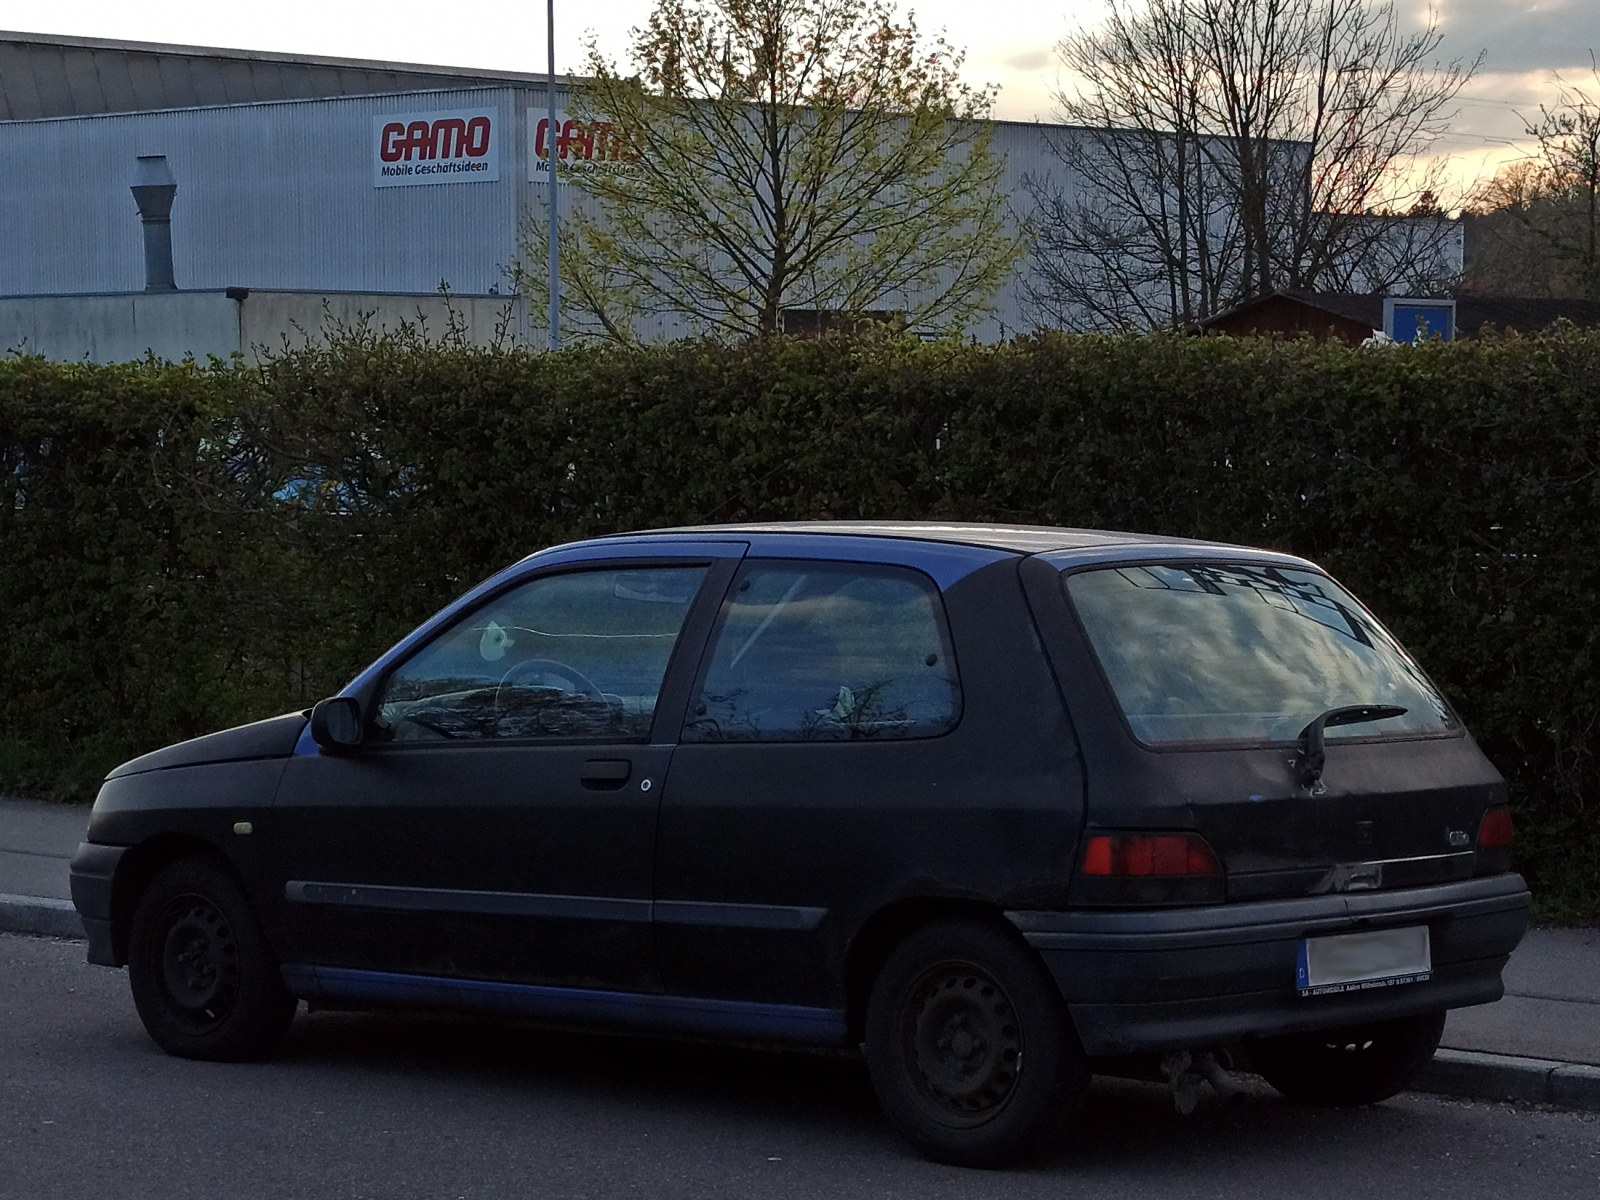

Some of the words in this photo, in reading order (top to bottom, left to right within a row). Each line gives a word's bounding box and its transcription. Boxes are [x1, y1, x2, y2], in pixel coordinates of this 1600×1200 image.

[381, 117, 491, 162] GAMO
[535, 118, 644, 163] GAM
[381, 164, 413, 176] Mobile
[415, 160, 488, 175] Geschäftsideen
[1299, 967, 1305, 979] D
